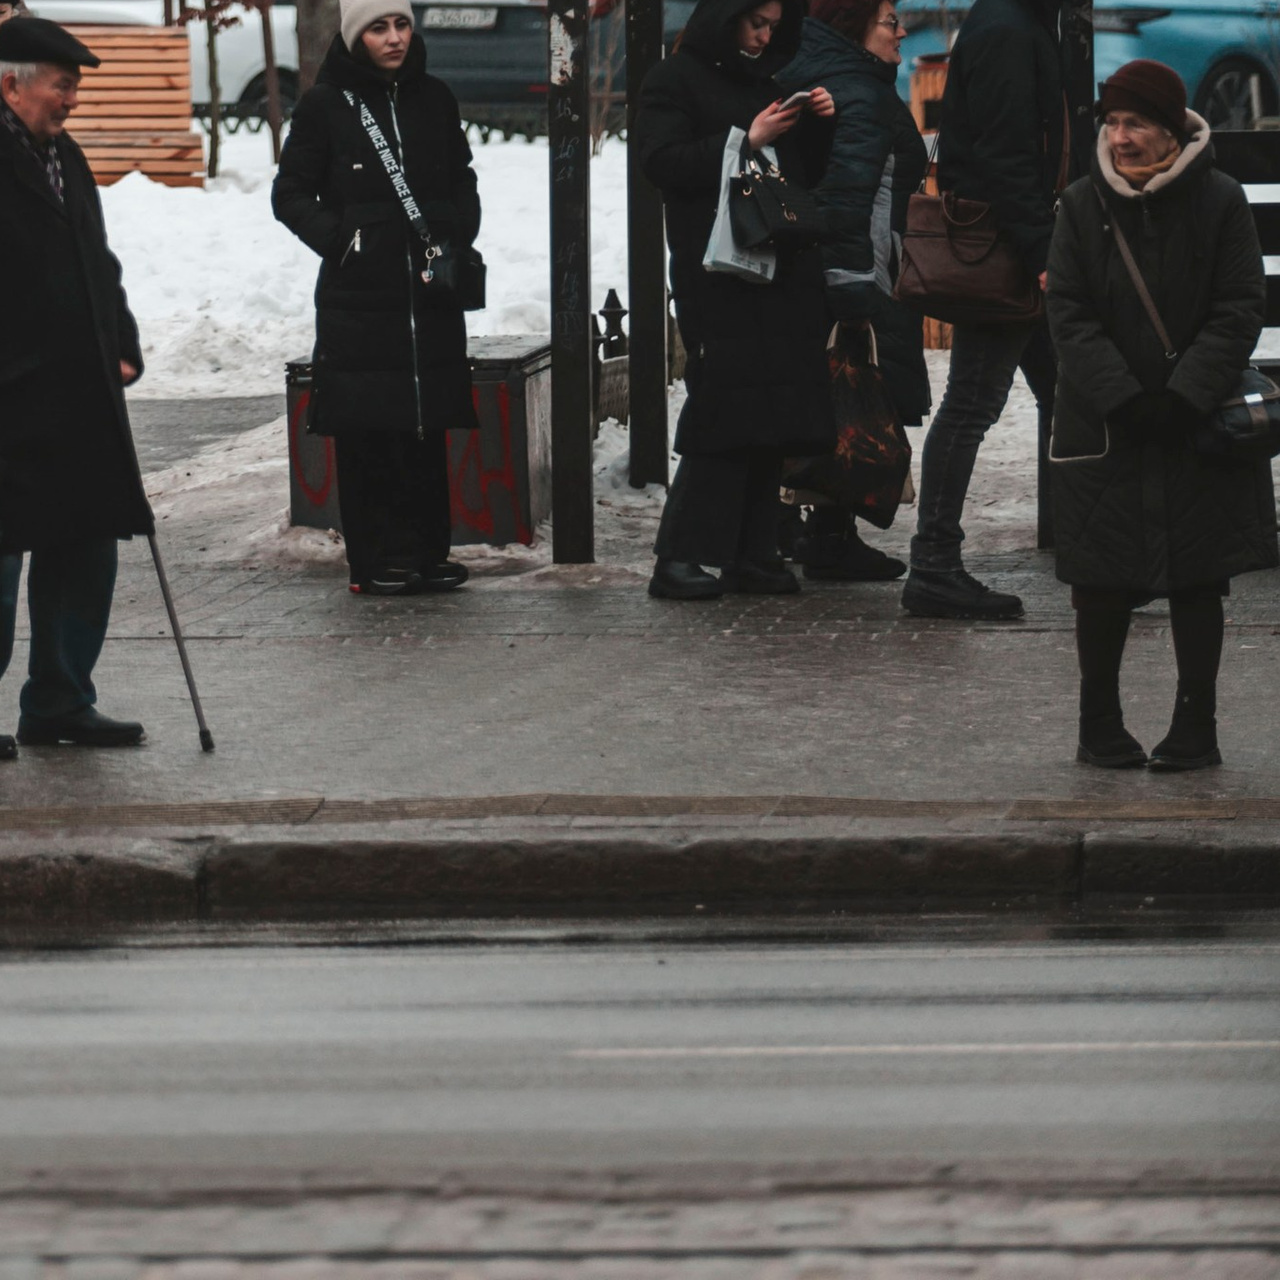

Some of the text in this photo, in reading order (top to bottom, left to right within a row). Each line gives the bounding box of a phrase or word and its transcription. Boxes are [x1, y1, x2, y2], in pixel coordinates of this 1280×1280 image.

[360, 103, 421, 220] NICE NICE NICE NICE NICE
